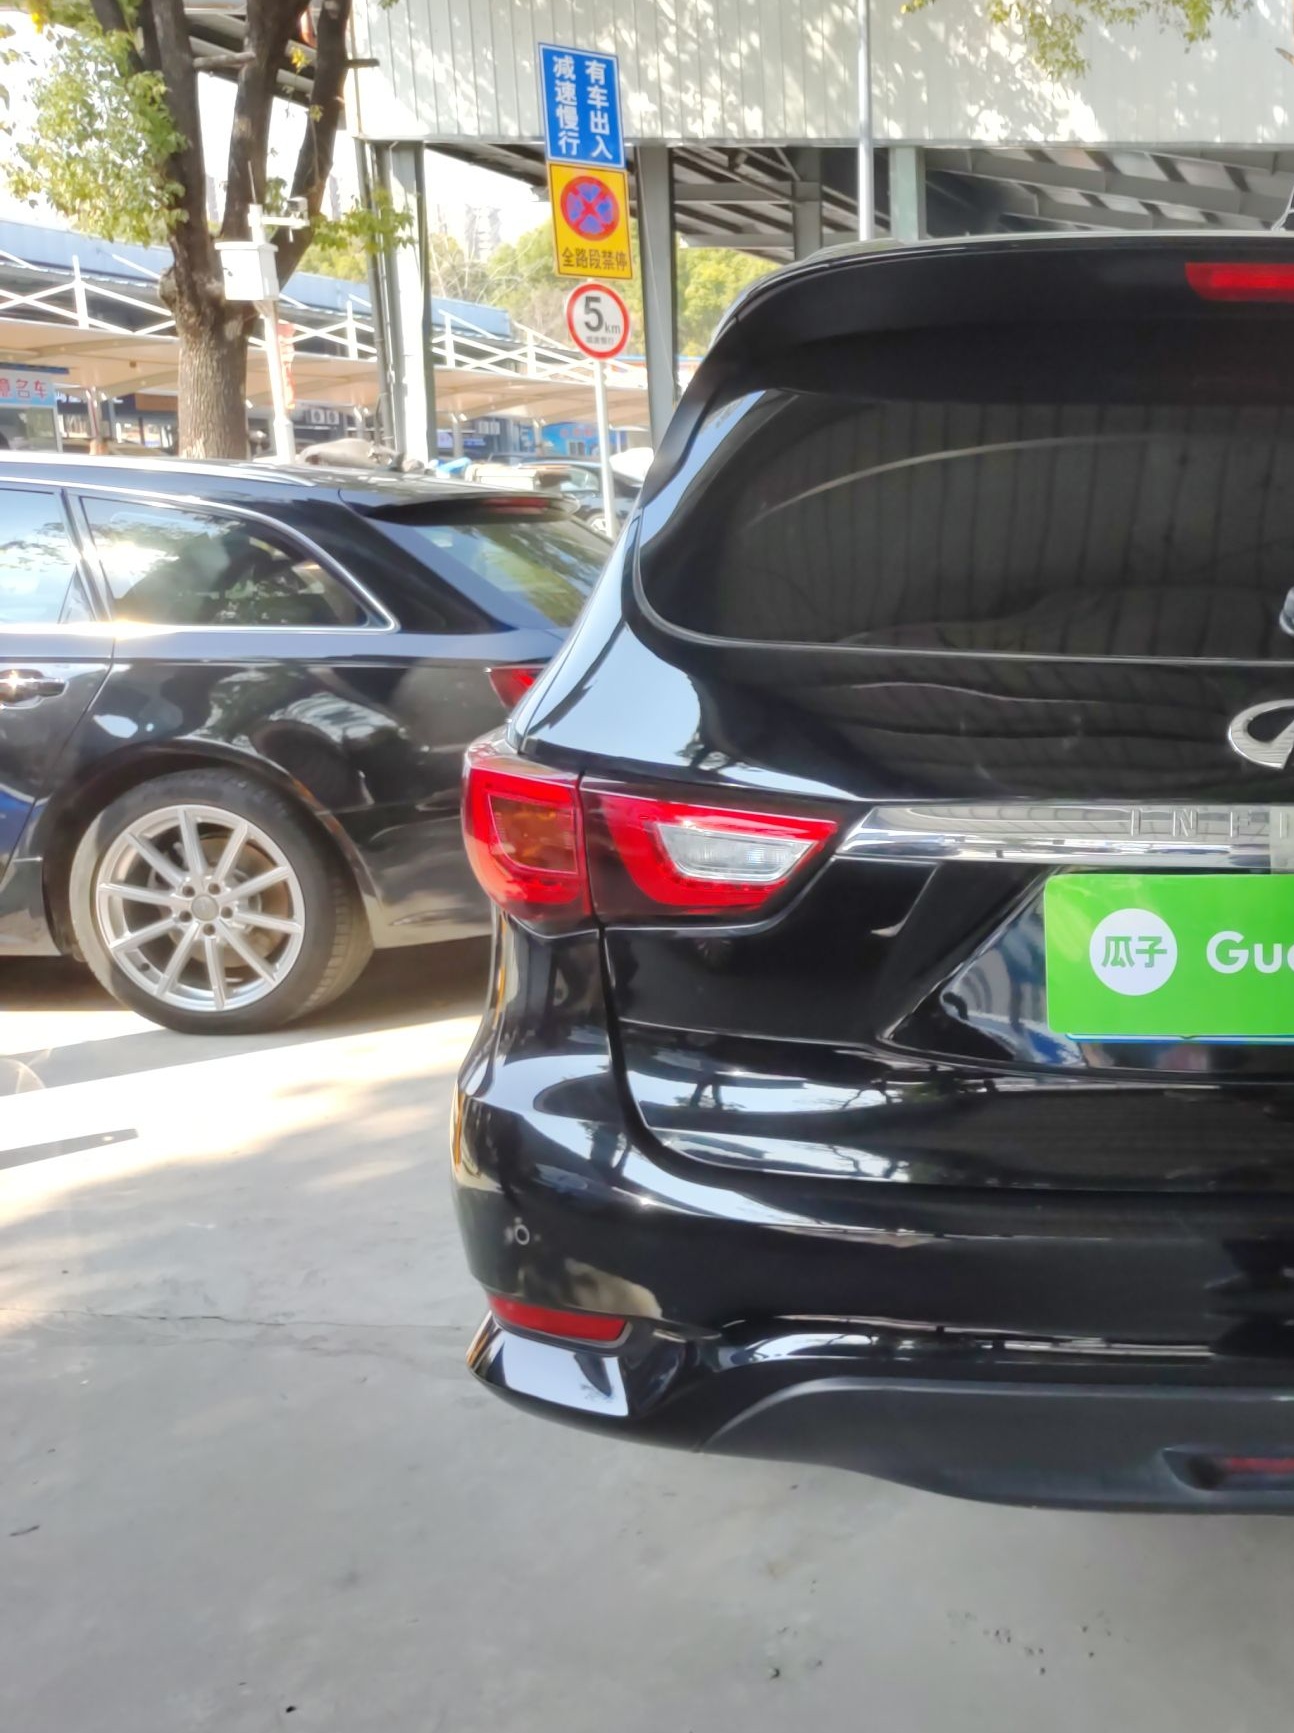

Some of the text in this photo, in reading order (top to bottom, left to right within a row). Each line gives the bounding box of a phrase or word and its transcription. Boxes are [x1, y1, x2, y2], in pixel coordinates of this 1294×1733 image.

[552, 54, 580, 156] 减速慢行
[584, 59, 614, 160] 有车出入
[561, 245, 628, 271] 全路段禁停
[1100, 935, 1168, 969] 瓜子
